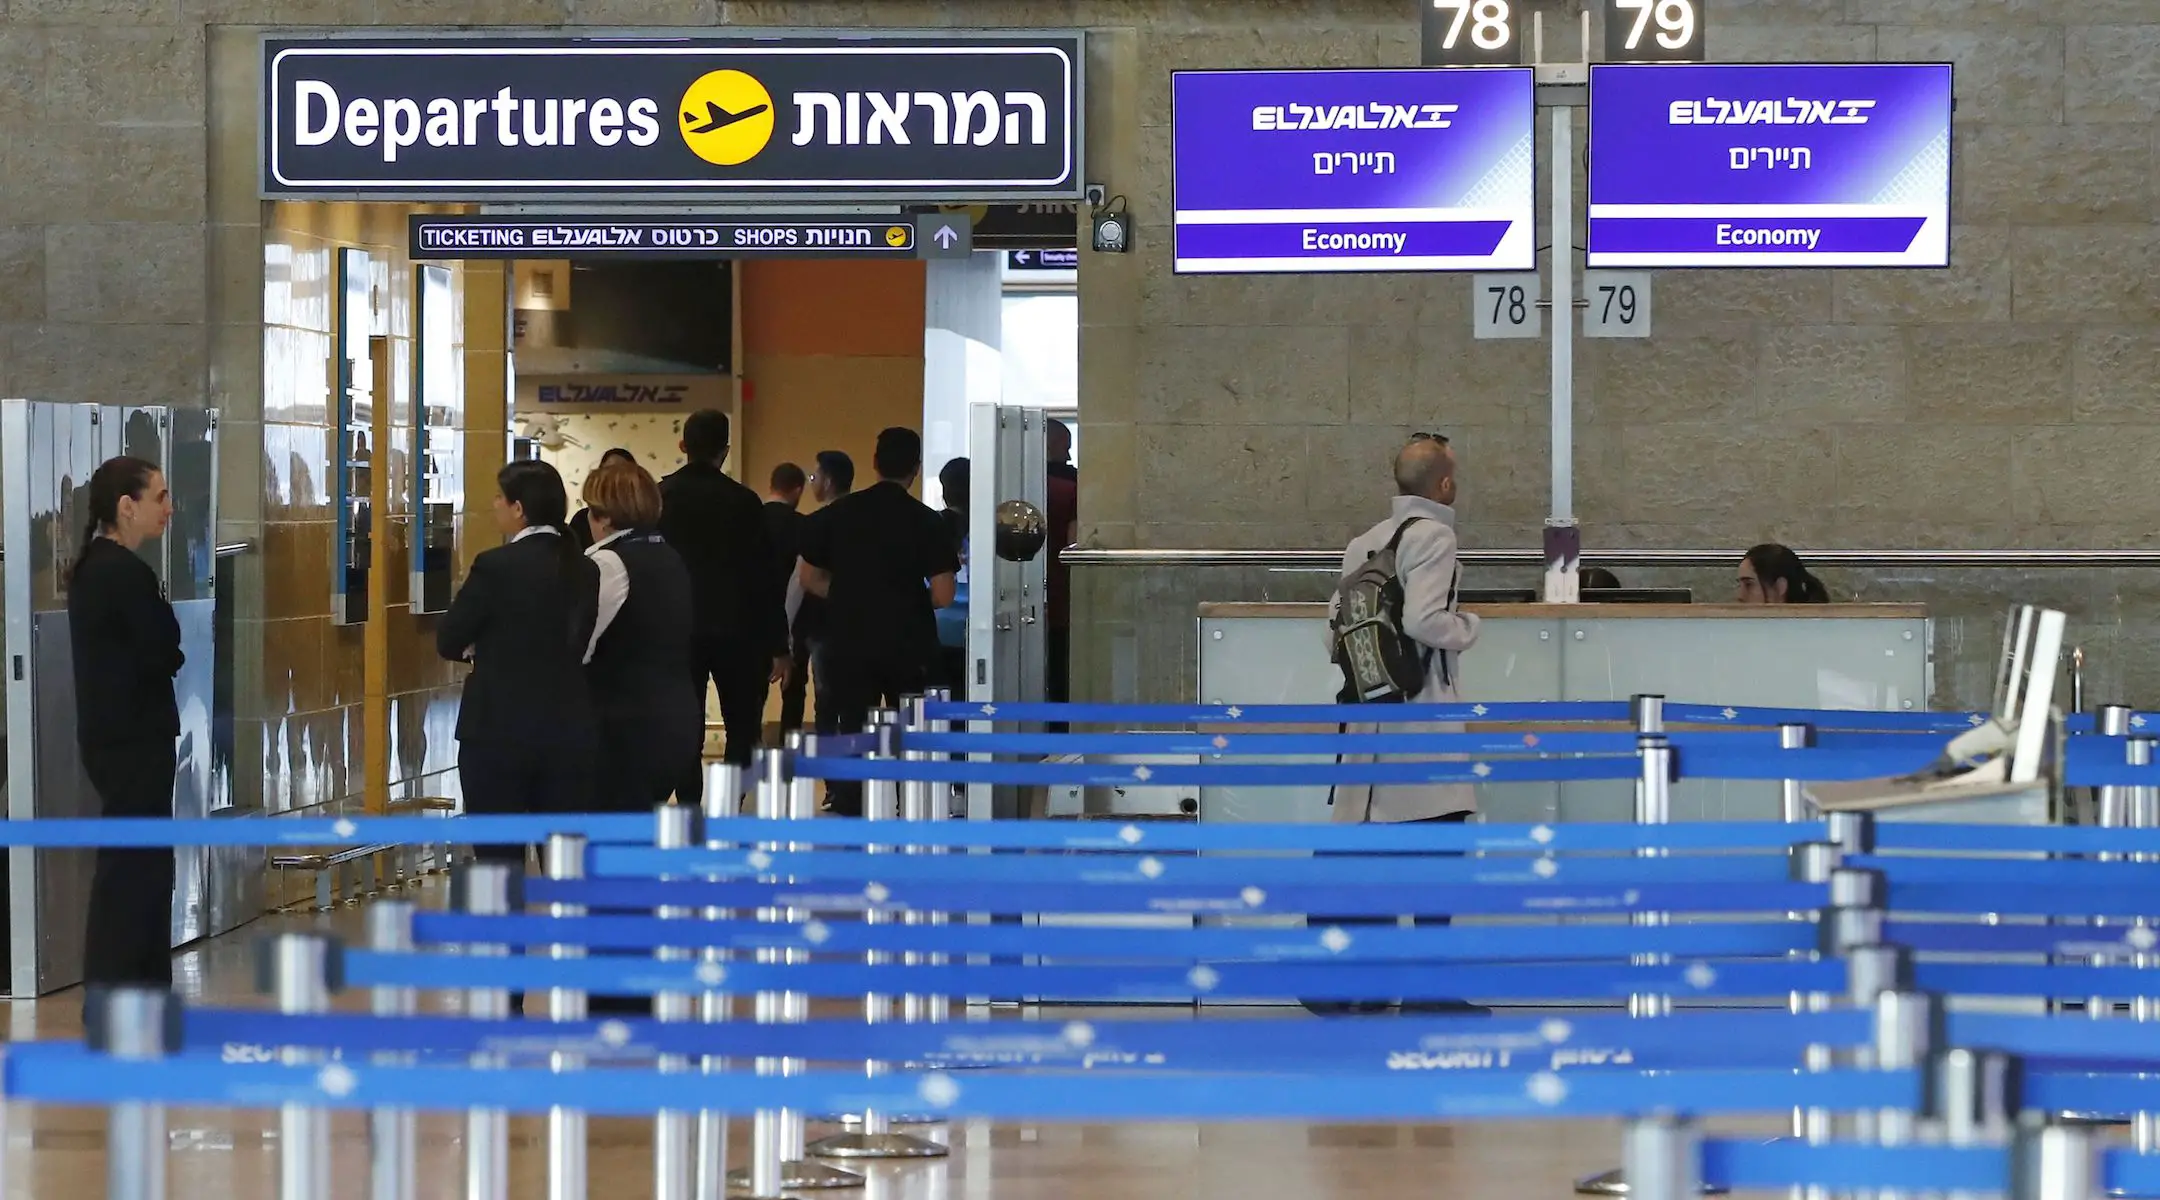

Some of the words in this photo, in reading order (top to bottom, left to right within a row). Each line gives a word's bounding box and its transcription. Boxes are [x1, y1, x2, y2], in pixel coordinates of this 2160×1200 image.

[1433, 0, 1510, 50] 78
[1615, 0, 1694, 50] 79
[295, 80, 660, 162] Departures
[792, 90, 1046, 147] המראות
[1312, 151, 1395, 175] תיירים
[1728, 147, 1811, 170] תיירים
[423, 228, 524, 246] TICKETING
[651, 228, 719, 246] כרטוס
[734, 228, 798, 246] SHOPS
[805, 228, 872, 246] חנויות
[1302, 228, 1407, 254] Economy
[1716, 223, 1821, 250] Economy
[1488, 285, 1526, 325] 78
[1598, 285, 1636, 325] 79
